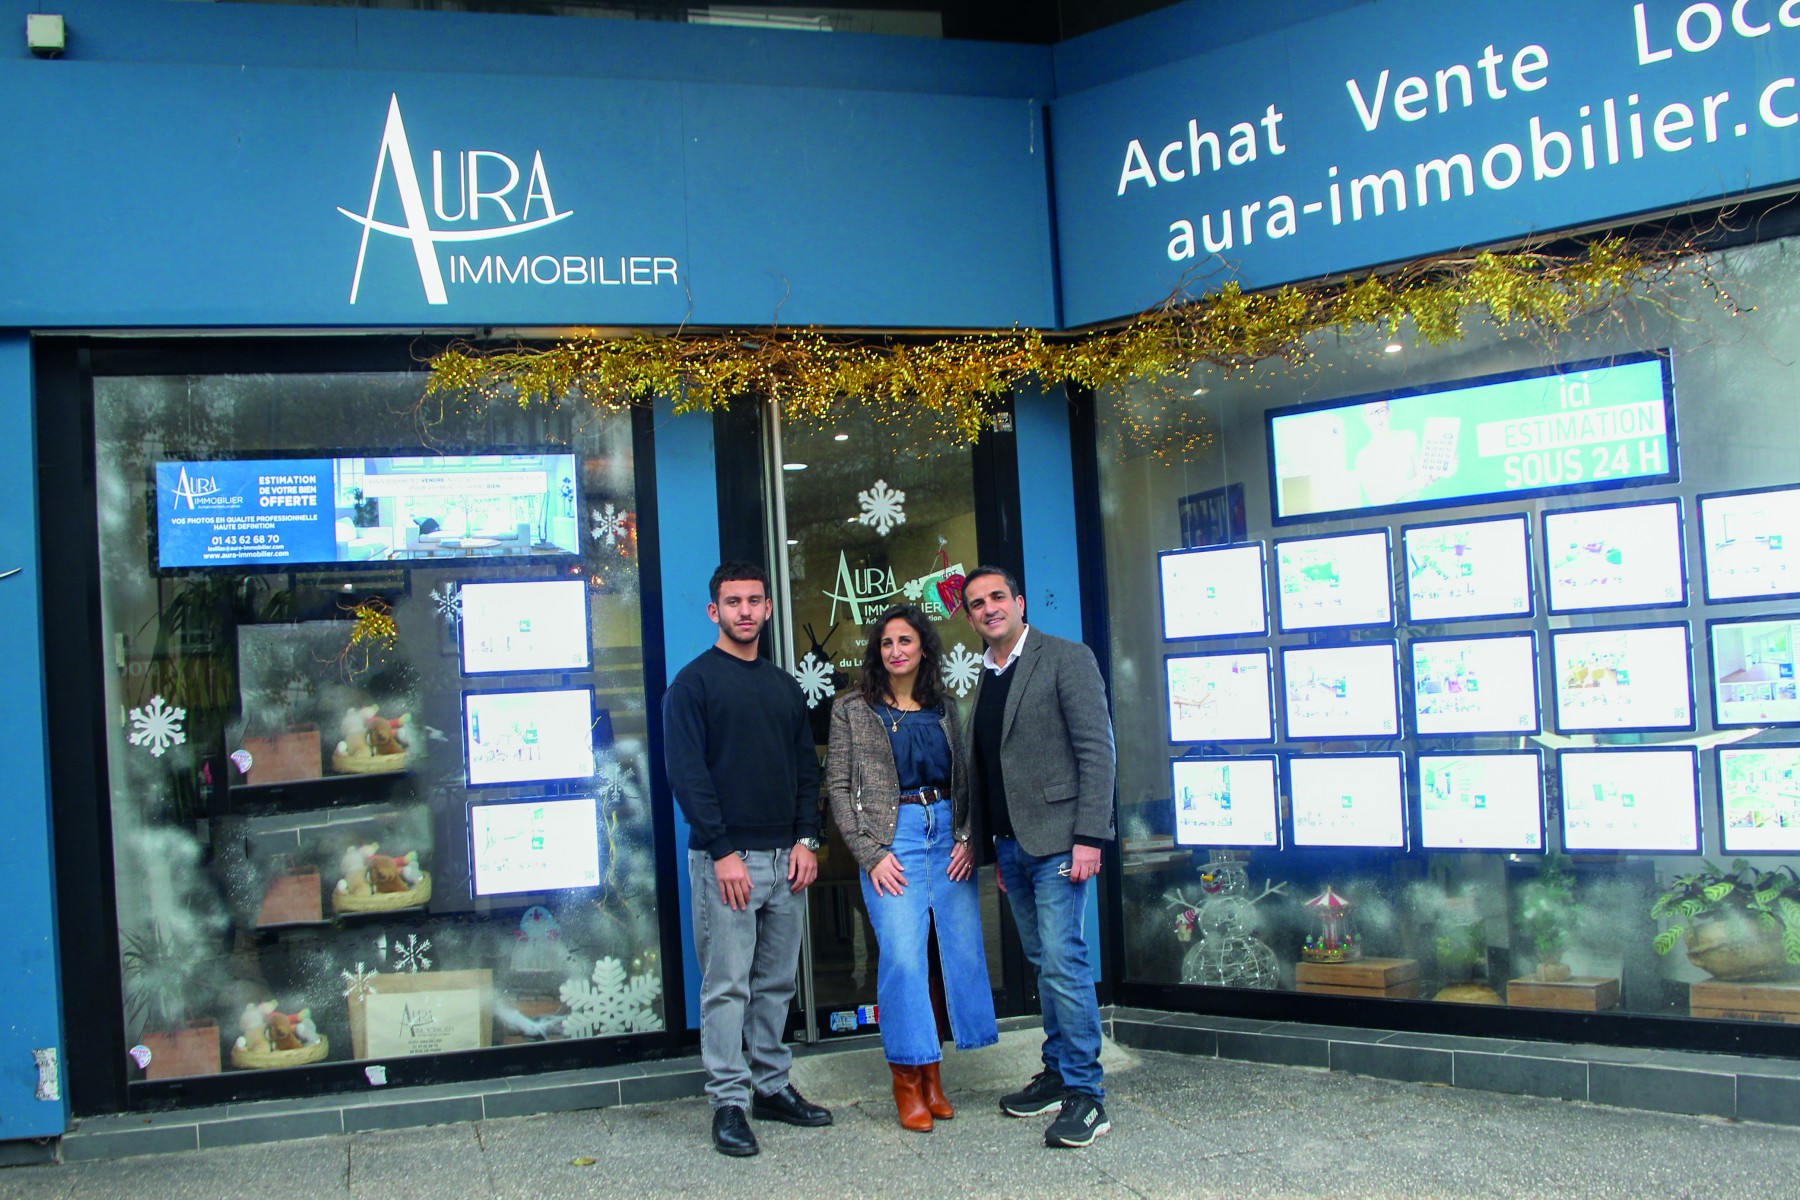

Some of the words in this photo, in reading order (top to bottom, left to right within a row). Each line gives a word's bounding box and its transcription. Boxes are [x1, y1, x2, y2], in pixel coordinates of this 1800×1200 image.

[1117, 104, 1287, 196] Achat
[1345, 43, 1550, 133] Vente
[1166, 77, 1799, 262] aura-immobilier.c
[337, 92, 573, 305] AURA
[450, 255, 679, 285] IMMOBILIER
[1504, 405, 1655, 448] ESTIMATION
[1503, 449, 1583, 488] SOUS
[1592, 445, 1631, 479] 24
[1639, 440, 1661, 472] H
[171, 466, 220, 510] AURA
[259, 475, 317, 485] ESTIMATION
[259, 486, 270, 495] DE
[271, 486, 298, 494] VOTRE
[298, 485, 317, 494] BIEN
[194, 496, 244, 505] IMMOBILIER
[260, 494, 318, 507] OFFERTE
[256, 514, 318, 522] PROFESSIONNELLE
[211, 536, 222, 545] 01
[224, 536, 237, 545] 43
[238, 535, 251, 544] 62
[253, 535, 265, 544] 68
[267, 534, 280, 543] 70
[203, 551, 289, 559] www.aura-immobilier.com
[822, 549, 905, 627] AURA
[840, 658, 852, 667] du
